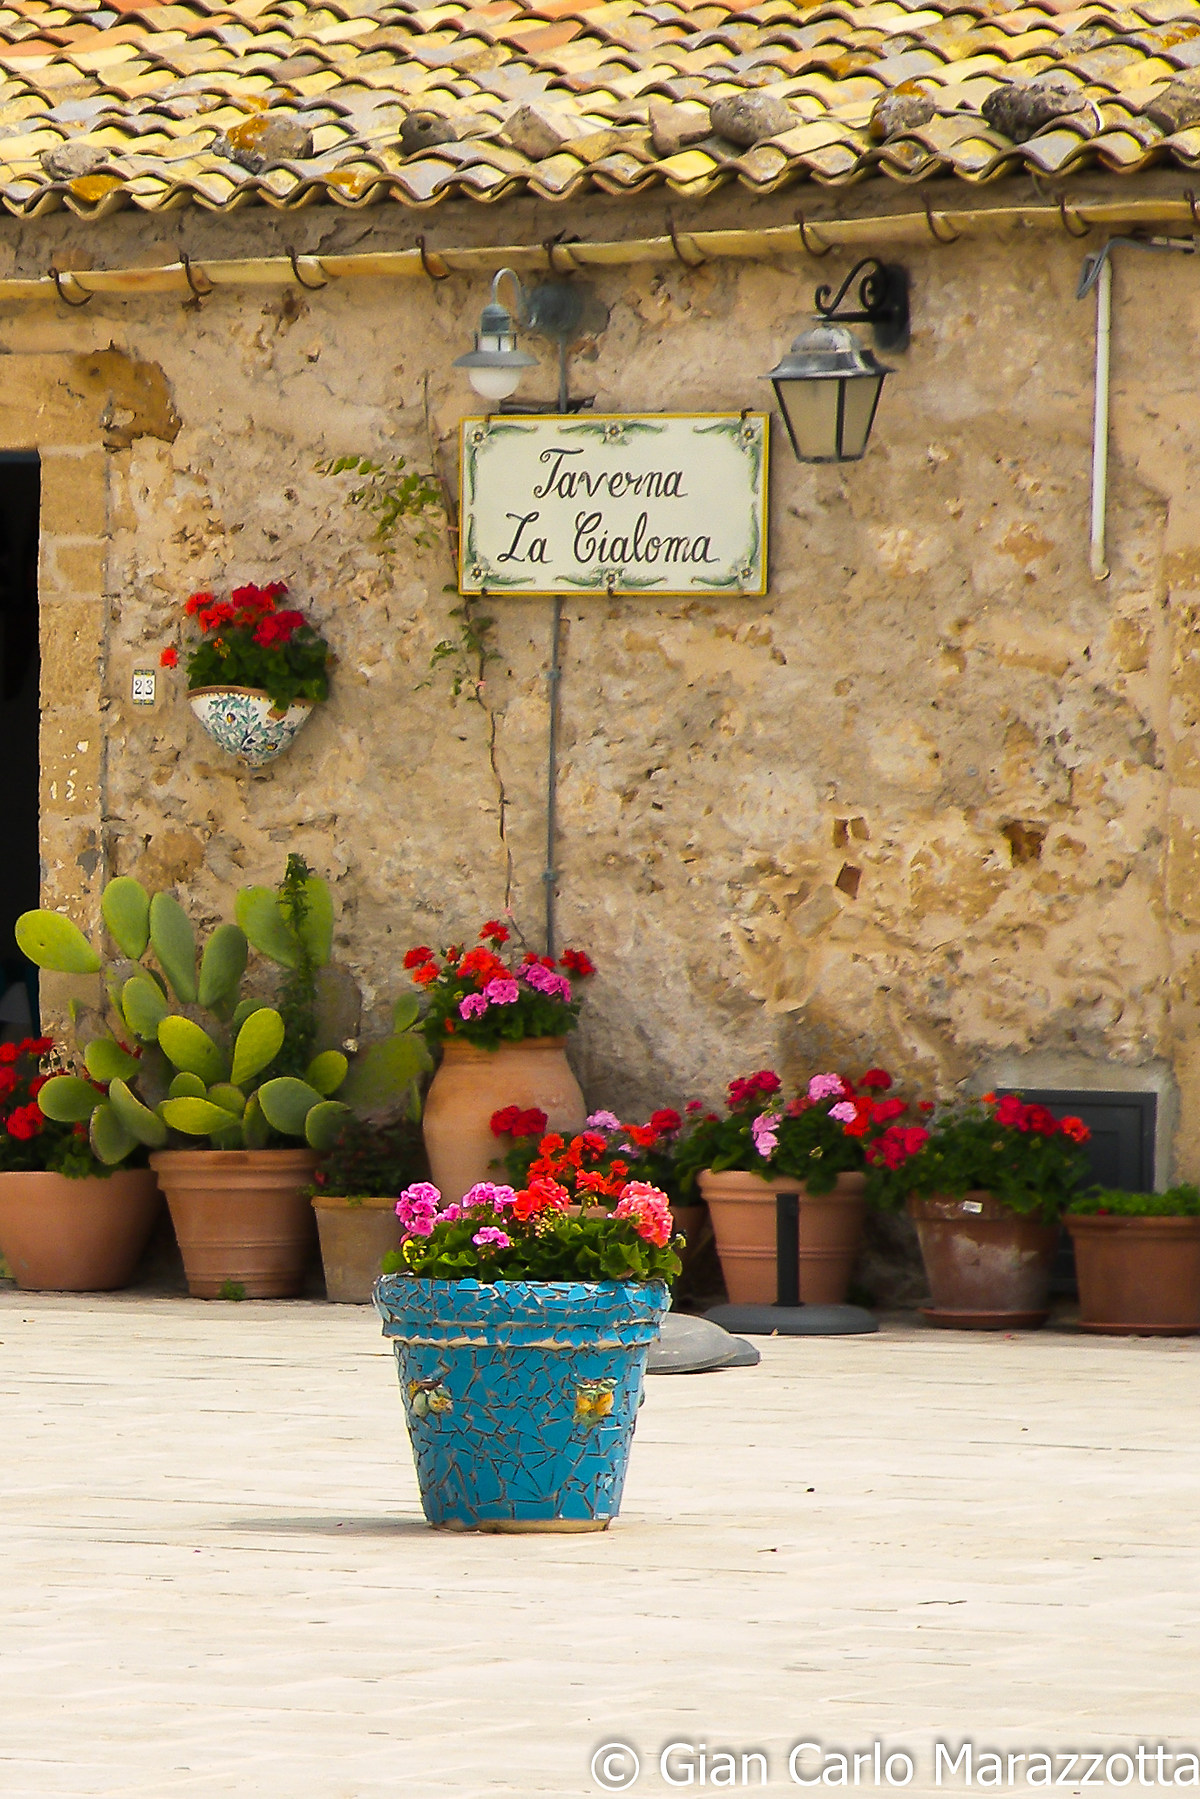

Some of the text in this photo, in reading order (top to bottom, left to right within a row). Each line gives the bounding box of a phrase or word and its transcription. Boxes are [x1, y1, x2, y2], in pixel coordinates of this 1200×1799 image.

[533, 447, 688, 498] Taverna
[496, 511, 720, 564] La Cialoma
[134, 679, 154, 695] 23
